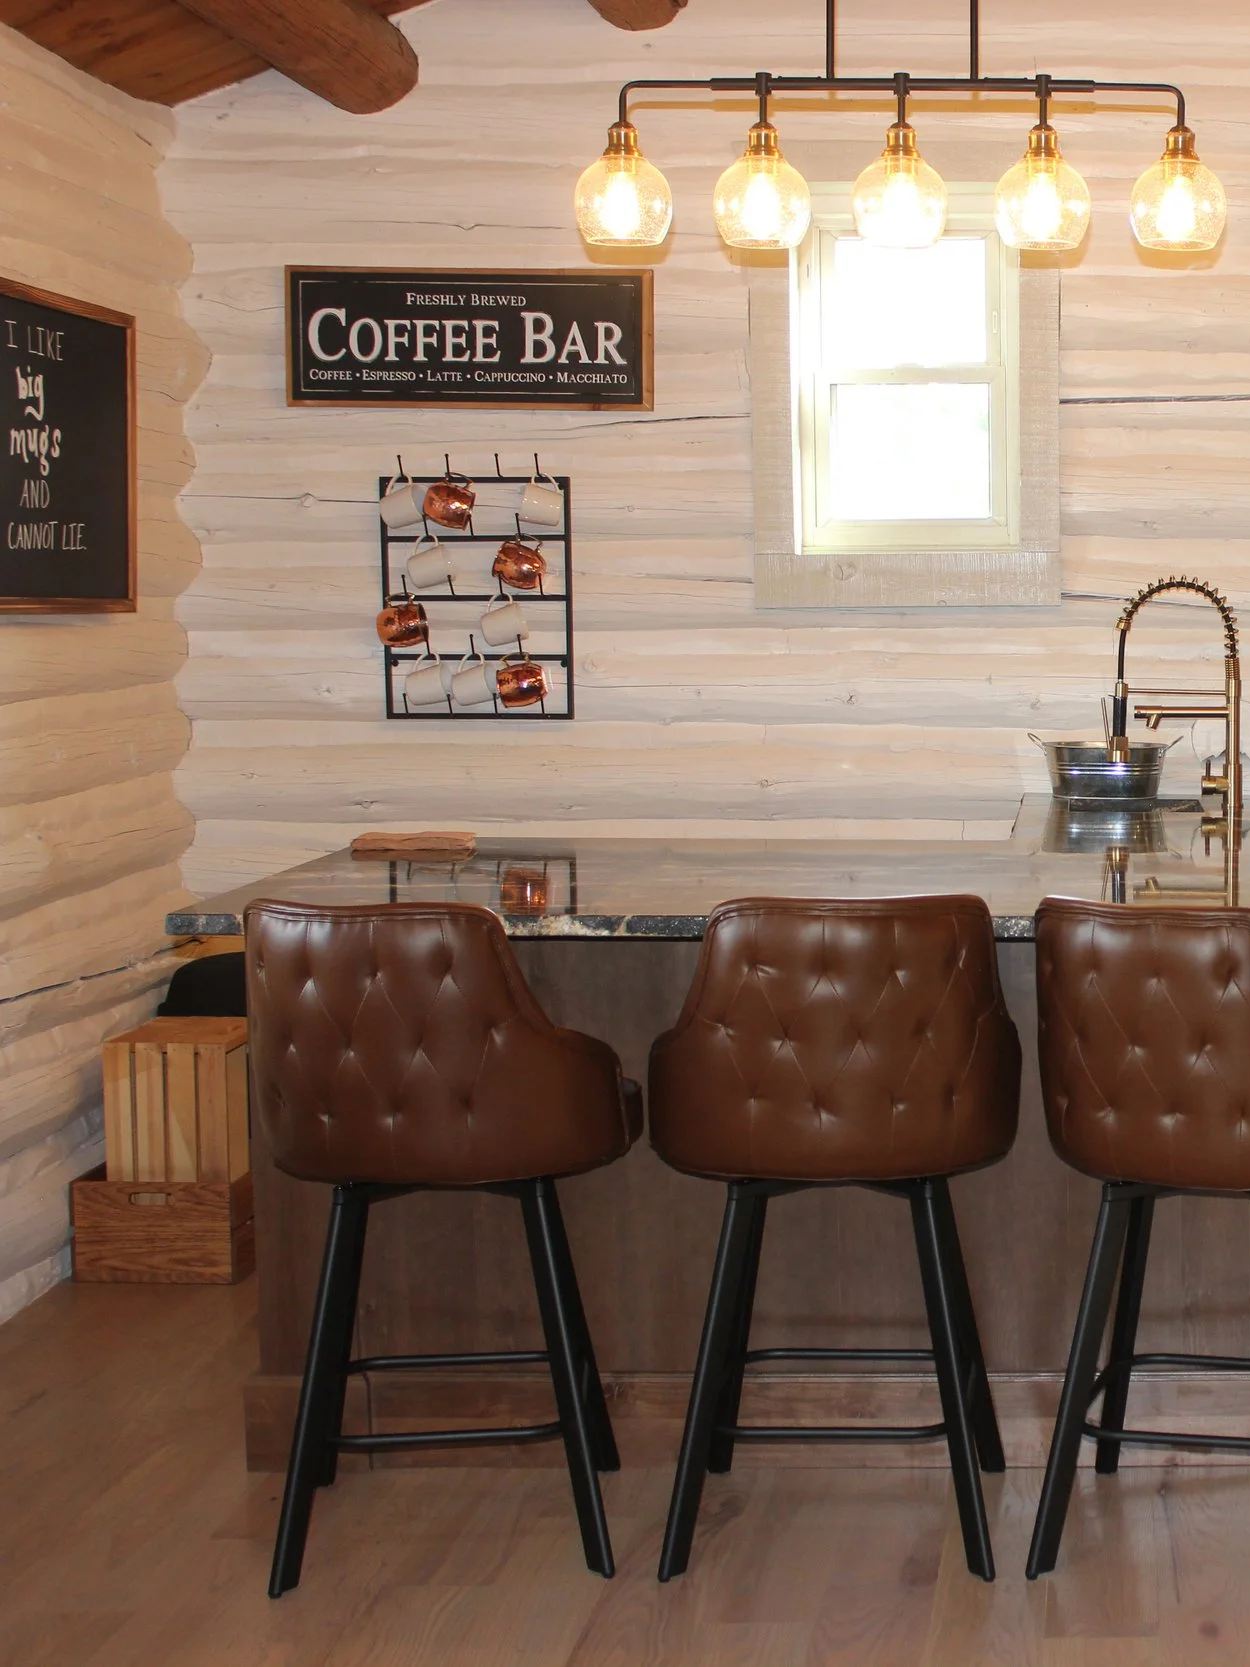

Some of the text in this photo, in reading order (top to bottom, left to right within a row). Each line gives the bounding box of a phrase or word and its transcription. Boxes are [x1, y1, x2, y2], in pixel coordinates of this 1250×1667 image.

[4, 320, 65, 361] I LIKE
[16, 365, 44, 421] big
[10, 424, 61, 477] mugs
[19, 479, 51, 509] AND
[7, 521, 58, 551] CANNOT
